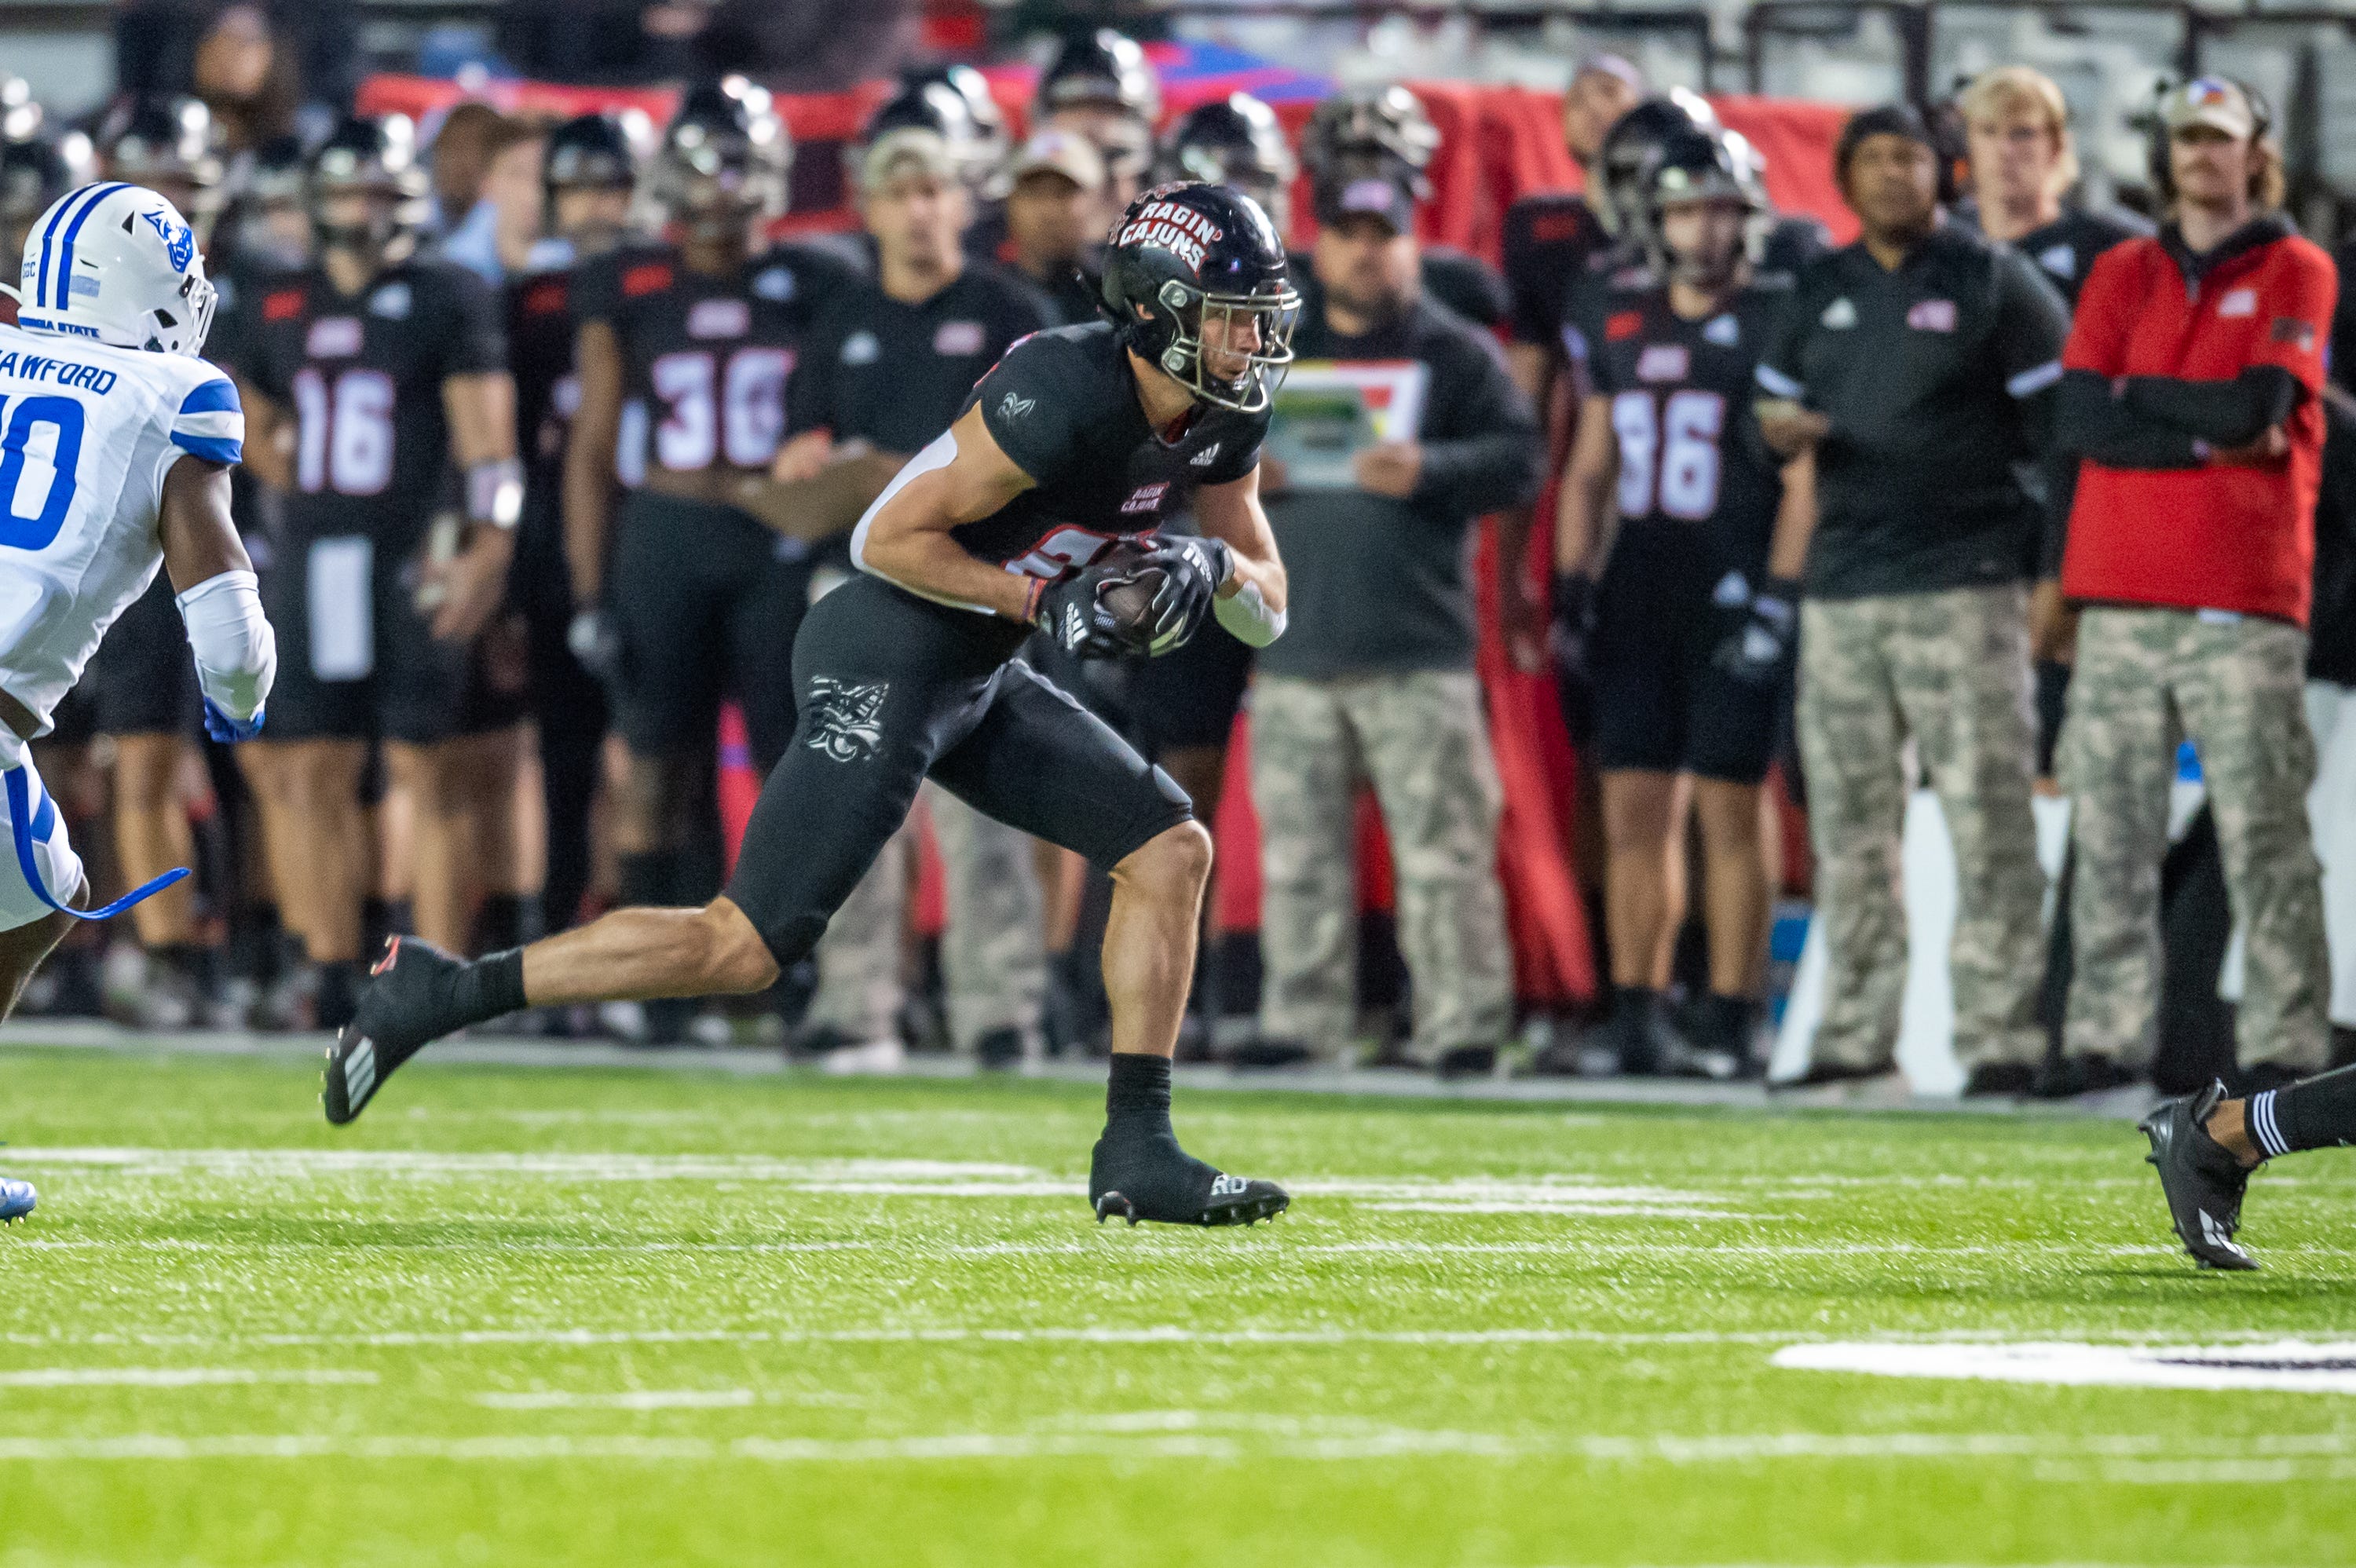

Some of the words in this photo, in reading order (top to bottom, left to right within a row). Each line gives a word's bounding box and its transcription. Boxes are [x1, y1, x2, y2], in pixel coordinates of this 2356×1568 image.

[1118, 221, 1207, 273] CAJUNS
[0, 350, 117, 396] AWFORD
[0, 394, 85, 551] 0
[291, 367, 395, 495] 16
